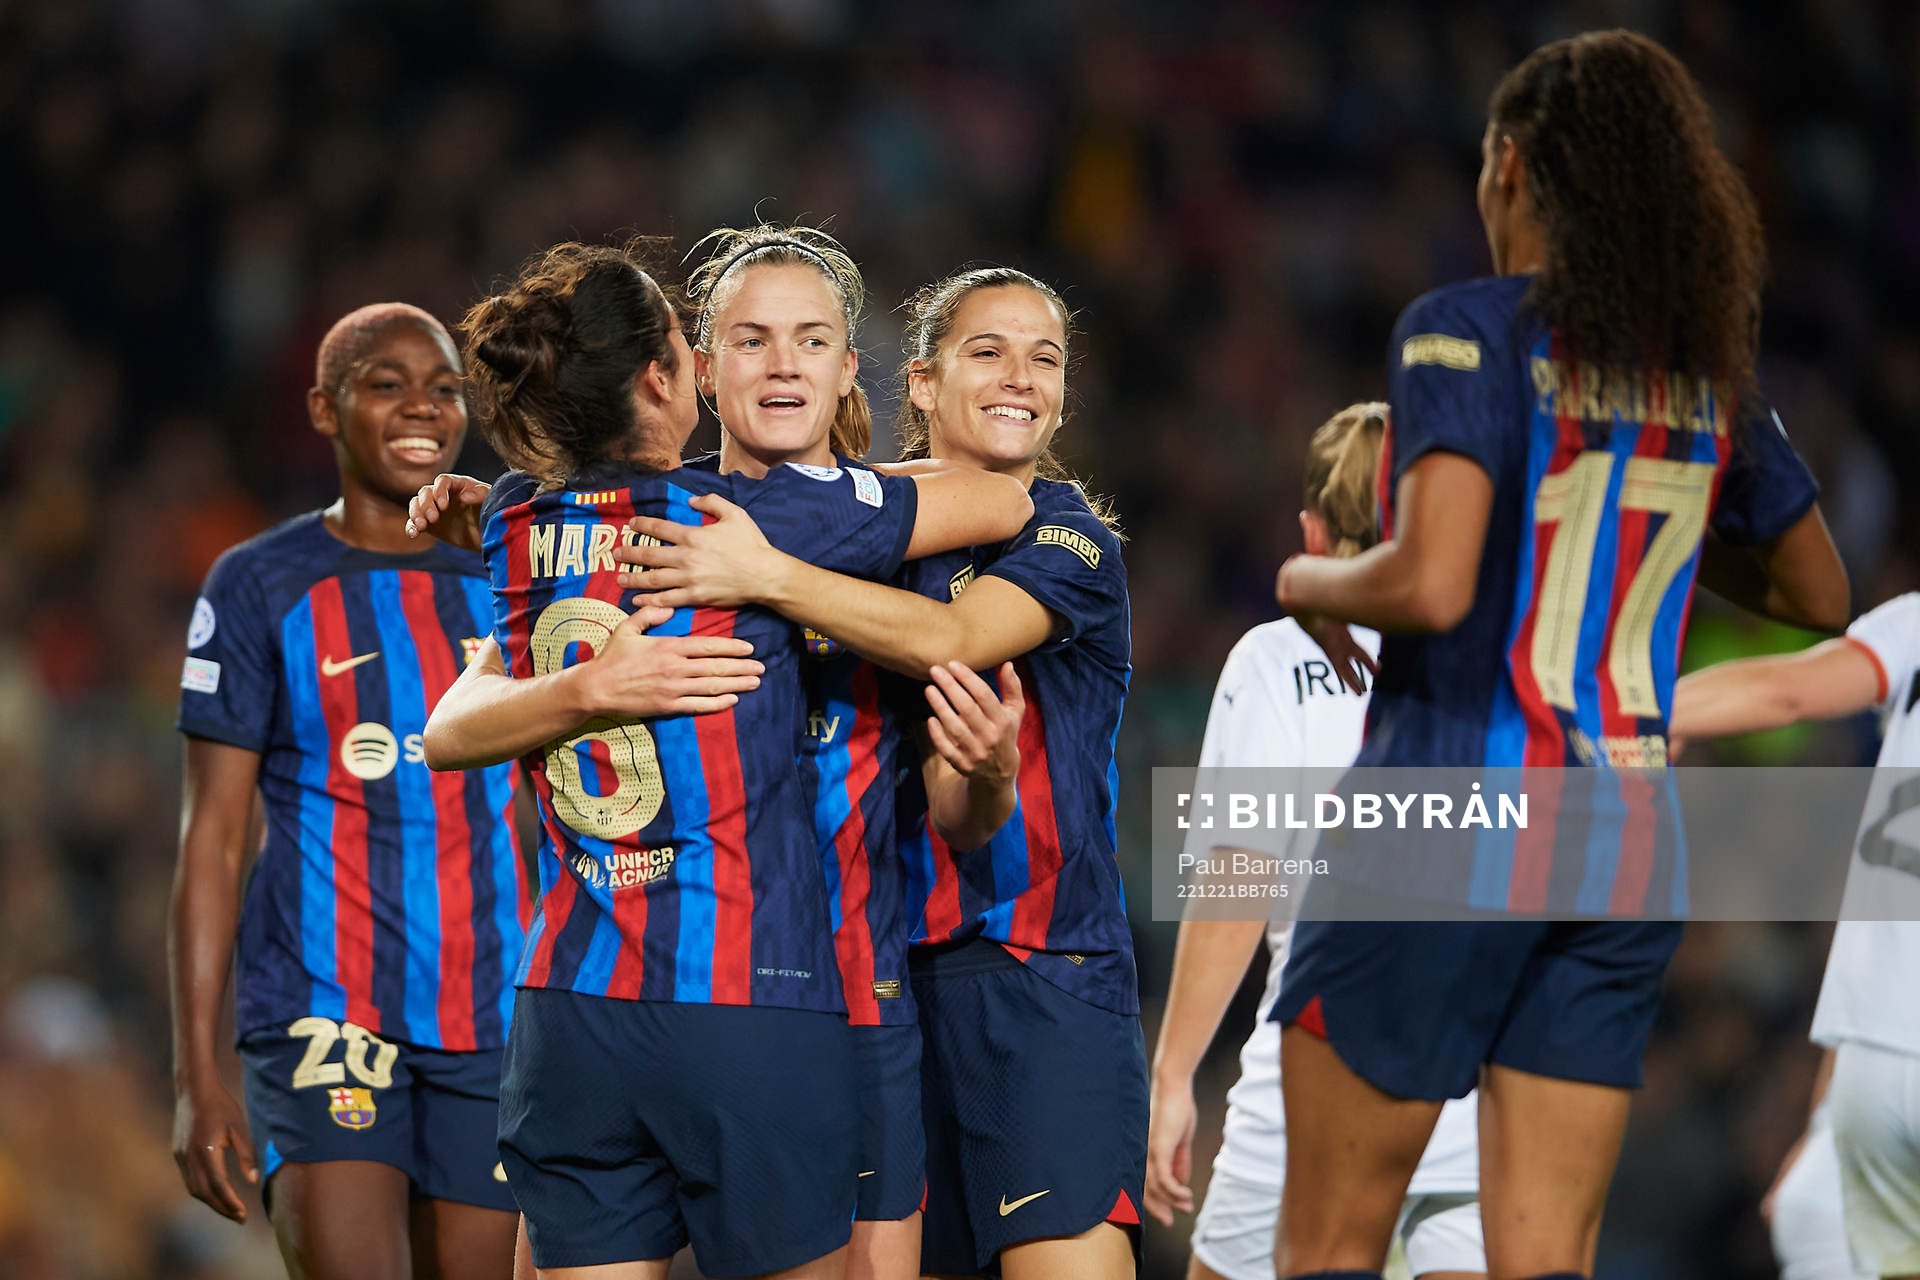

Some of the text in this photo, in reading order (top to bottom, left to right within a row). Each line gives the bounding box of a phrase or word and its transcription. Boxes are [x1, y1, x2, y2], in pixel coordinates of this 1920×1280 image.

[1036, 528, 1100, 567] BIMBO
[1530, 450, 1718, 718] 17
[604, 847, 675, 872] UNHCR
[288, 1016, 398, 1089] 20
